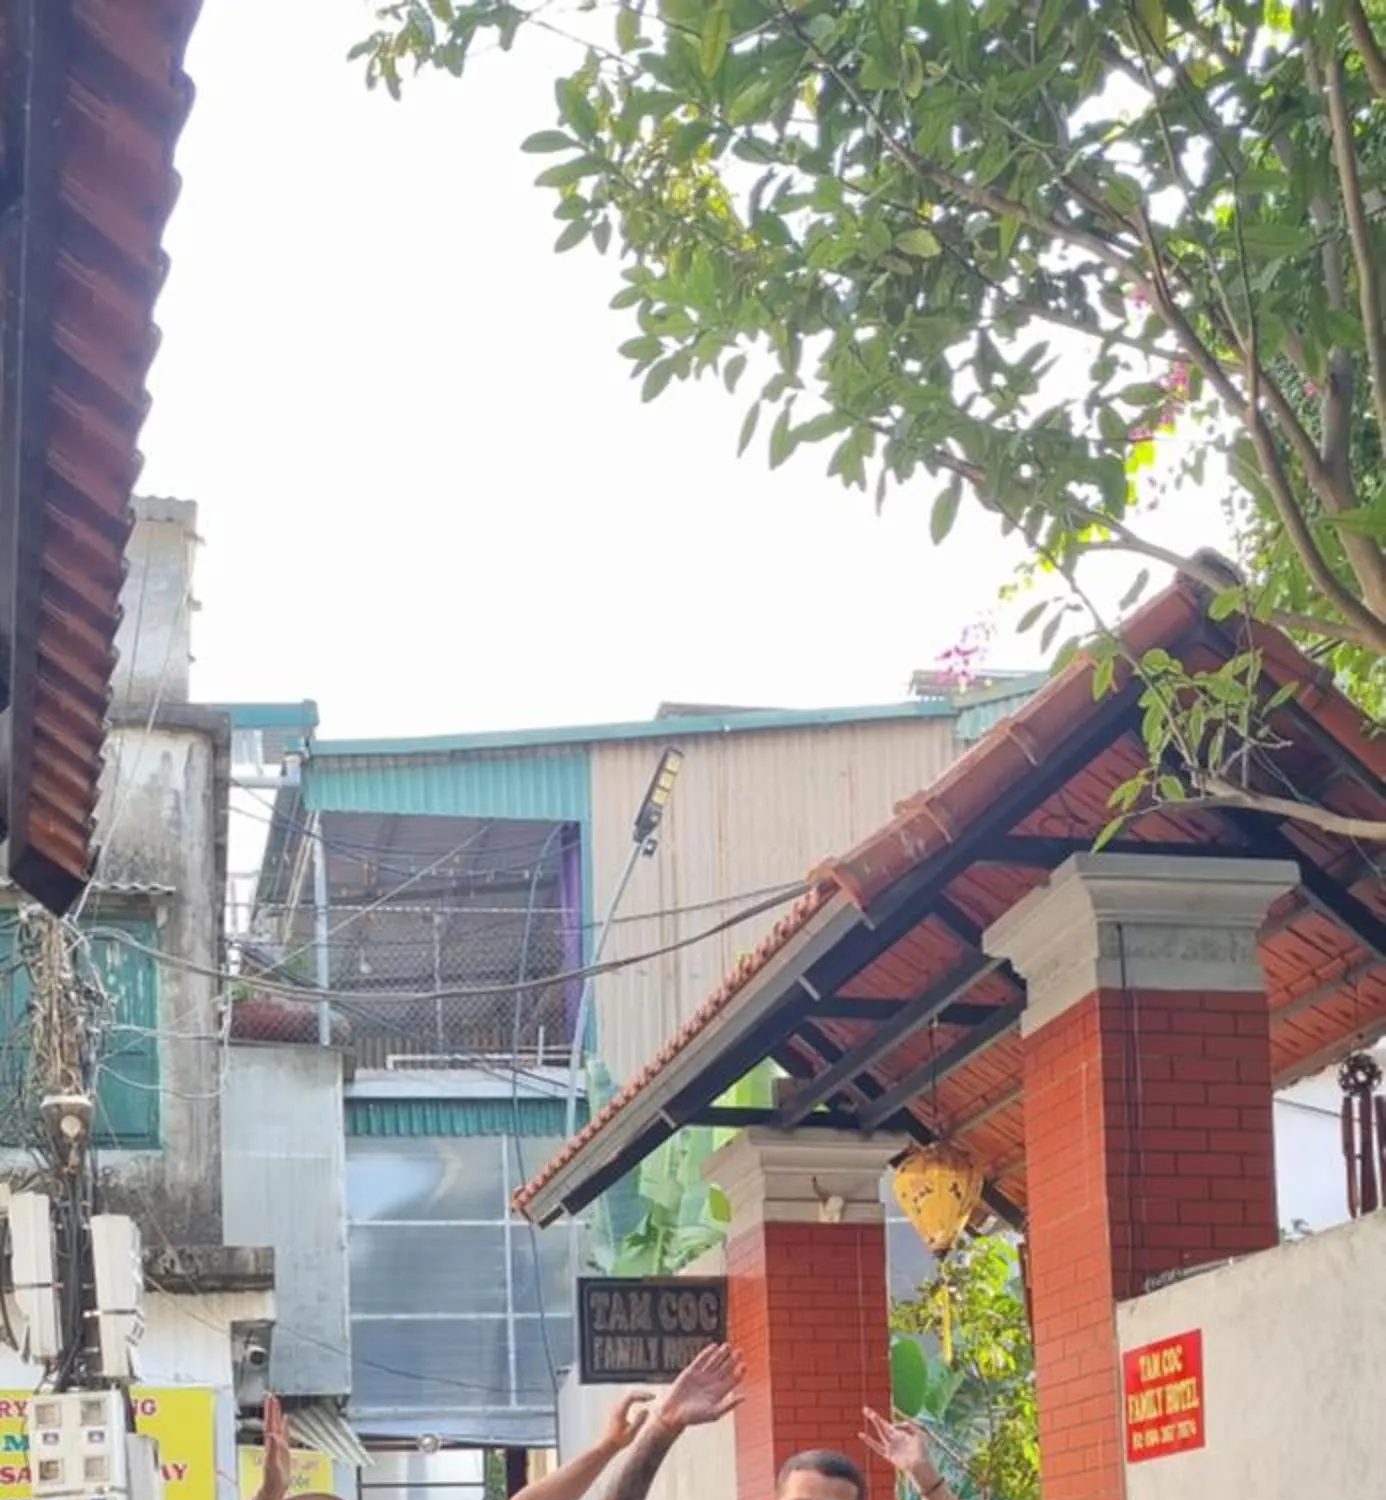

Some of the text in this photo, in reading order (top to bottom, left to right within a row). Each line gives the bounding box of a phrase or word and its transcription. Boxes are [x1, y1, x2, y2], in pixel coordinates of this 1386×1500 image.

[590, 1292, 719, 1332] TAM COC
[593, 1336, 659, 1370] FAMILY
